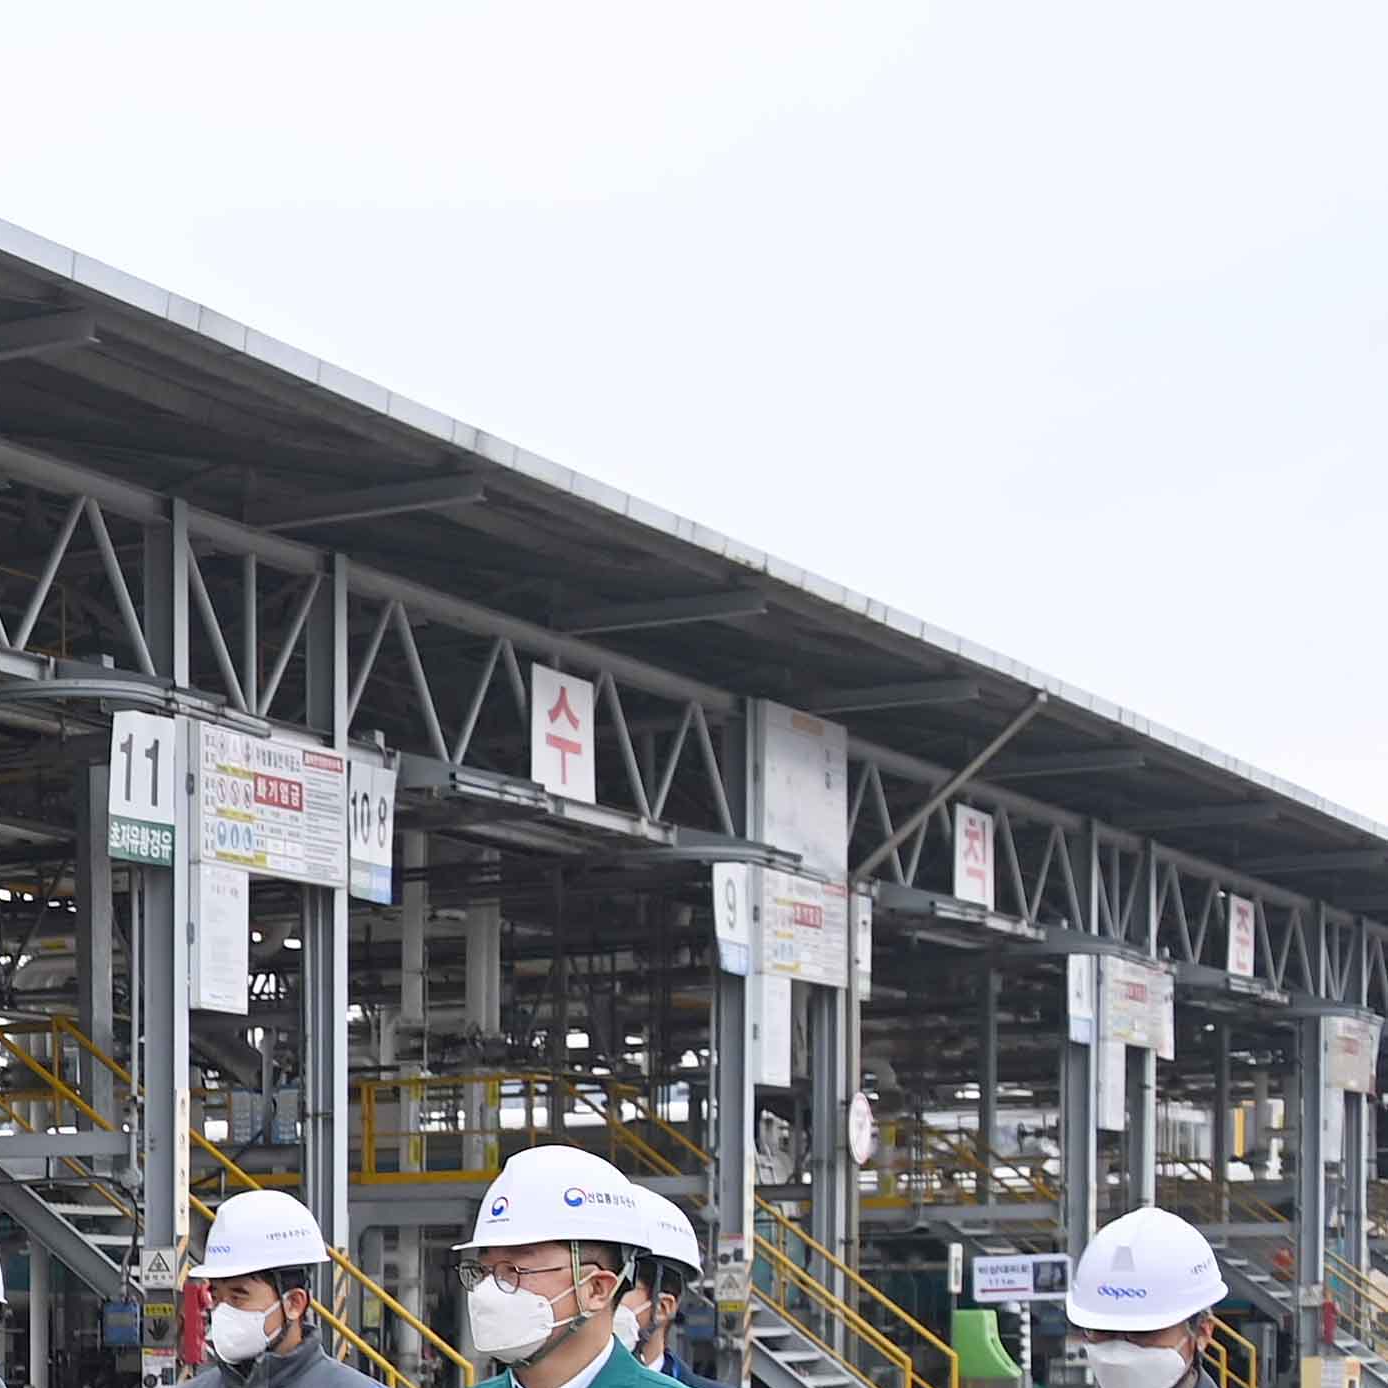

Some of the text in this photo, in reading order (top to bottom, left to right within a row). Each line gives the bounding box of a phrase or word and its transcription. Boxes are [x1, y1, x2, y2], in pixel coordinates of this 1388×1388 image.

[545, 685, 583, 785] 수
[120, 733, 160, 807] 11
[108, 820, 173, 860] 초저유황경유
[351, 790, 372, 845] 10
[377, 795, 389, 849] 8
[726, 877, 737, 930] 9
